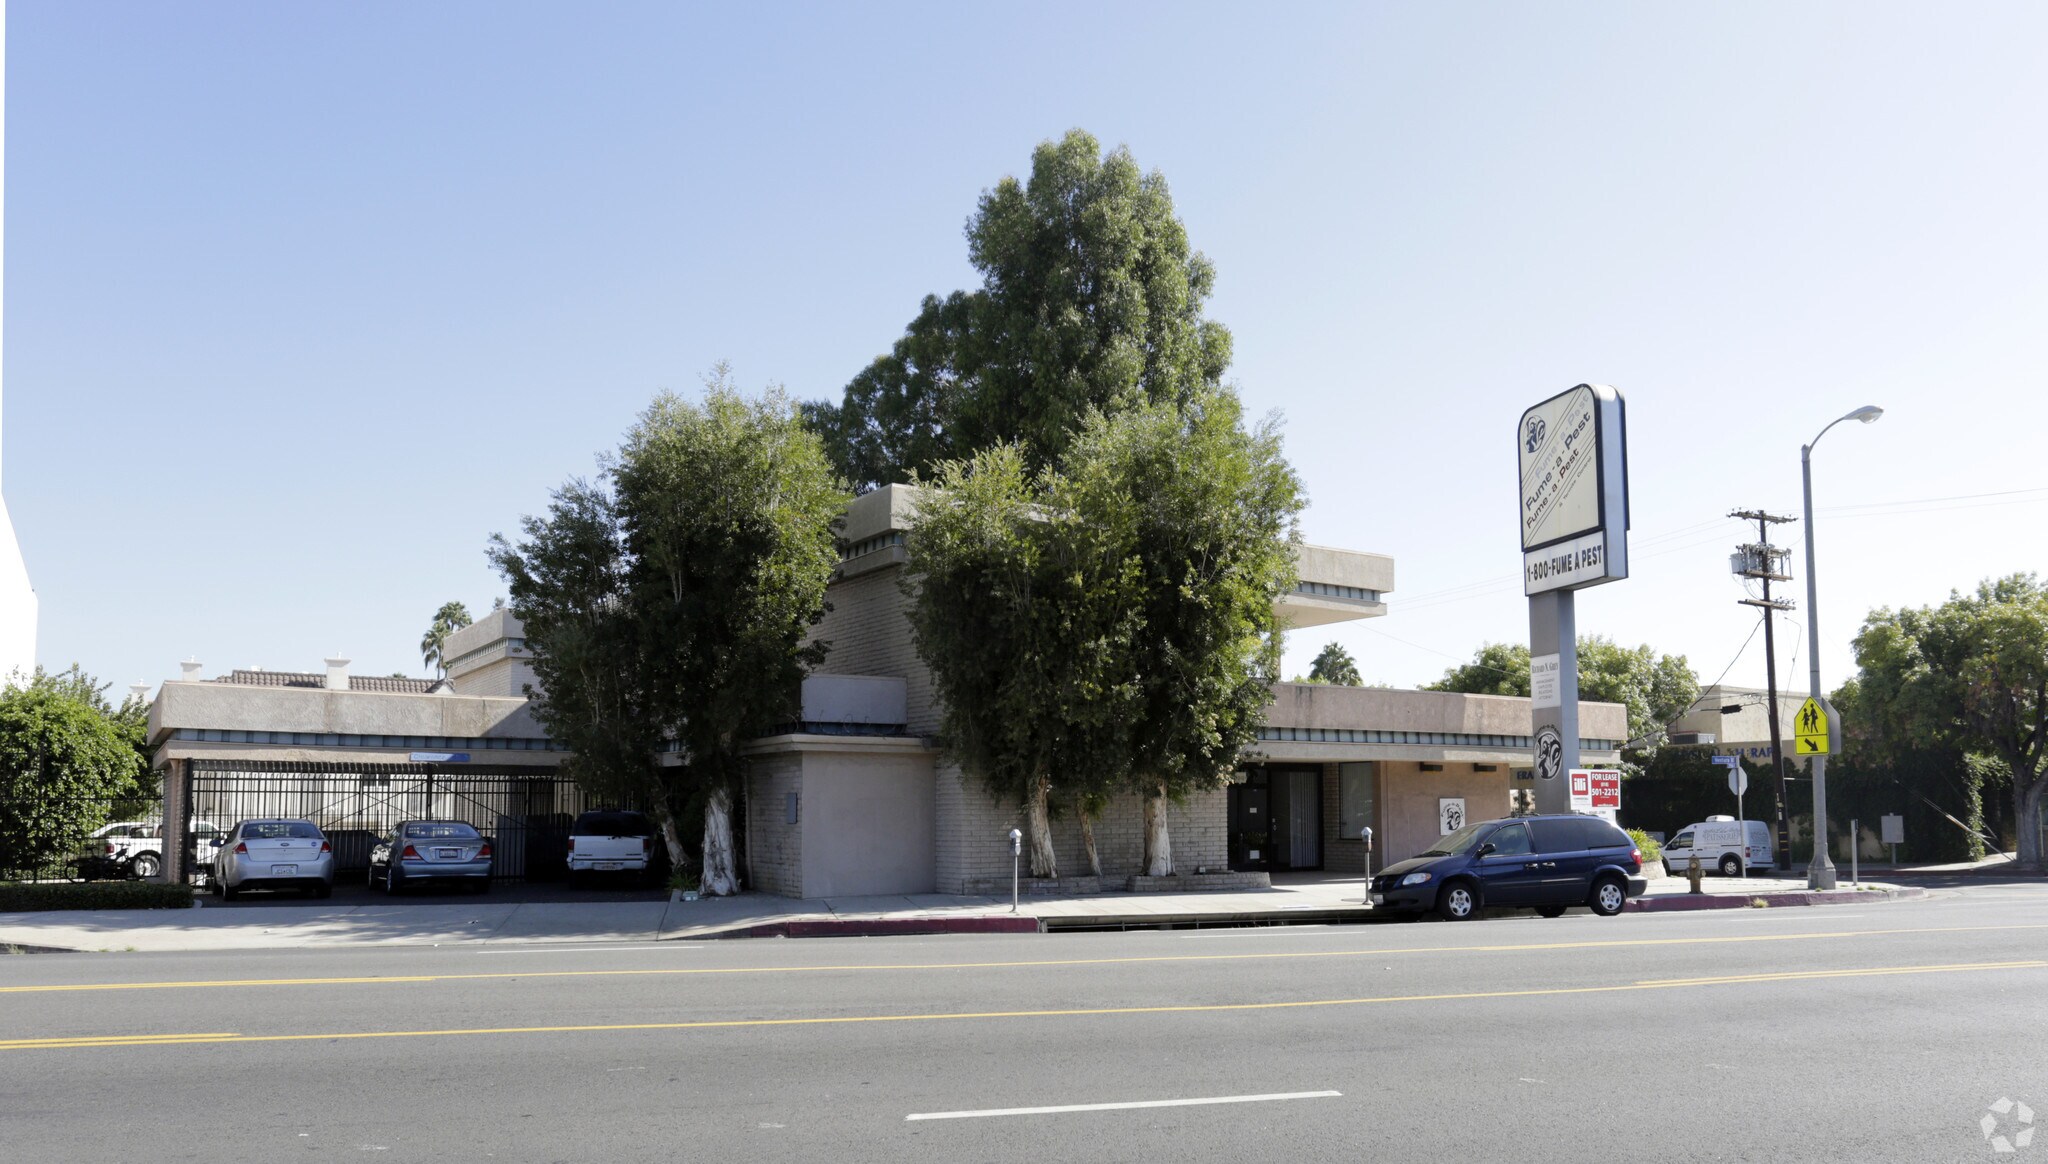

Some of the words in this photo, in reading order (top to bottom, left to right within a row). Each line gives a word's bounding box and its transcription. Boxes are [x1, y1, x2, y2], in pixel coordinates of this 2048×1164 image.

[1525, 471, 1553, 512] Fume
[1564, 411, 1591, 450] Pest
[1526, 495, 1548, 529] Fume
[1559, 448, 1579, 480] Pest
[1527, 553, 1573, 583] 1-800-FUME
[1574, 551, 1581, 571] A
[1582, 545, 1602, 568] PEST
[1591, 788, 1619, 796] 501-2212
